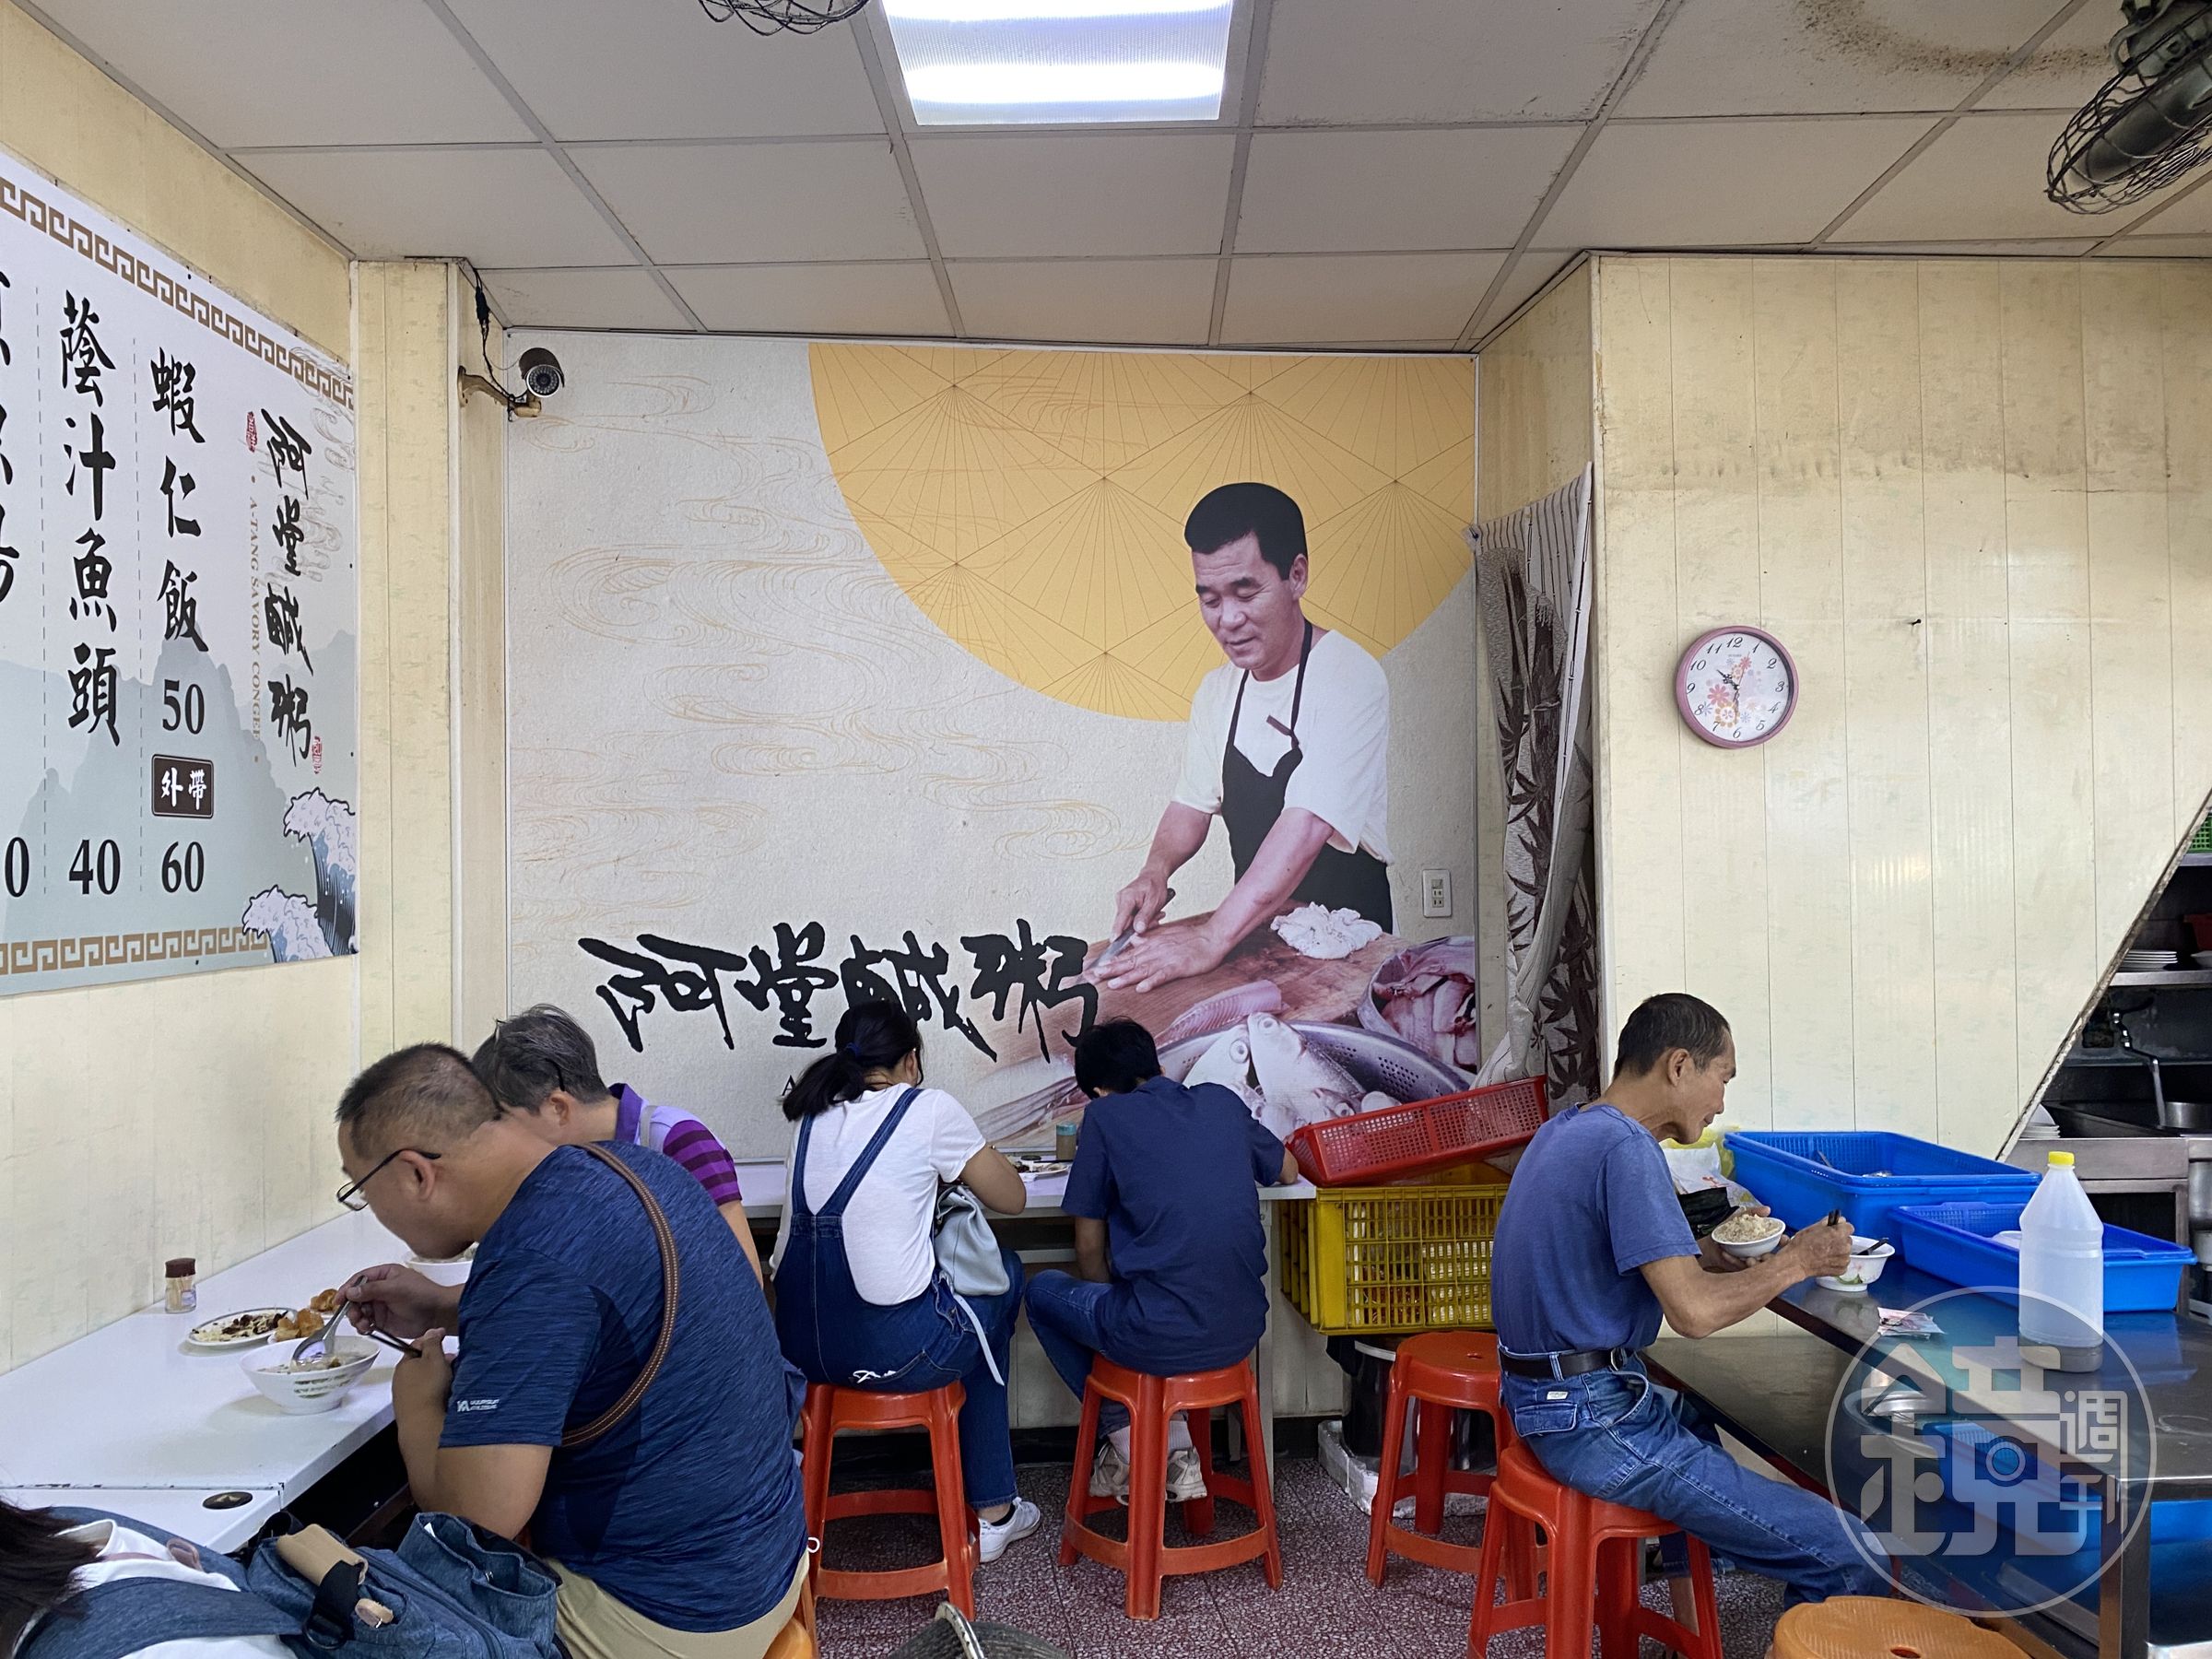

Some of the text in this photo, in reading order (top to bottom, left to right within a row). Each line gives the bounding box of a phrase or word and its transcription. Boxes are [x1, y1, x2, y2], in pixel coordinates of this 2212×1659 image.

[150, 347, 209, 652] 蝦仁飯
[60, 289, 120, 747] 蔭汁魚頭
[250, 497, 259, 571] A-TANG
[250, 576, 260, 655] SAVORY
[1706, 643, 1723, 654] 11
[1726, 636, 1743, 648] 12
[1752, 642, 1760, 653] 1
[1690, 659, 1706, 671] 10
[1767, 657, 1777, 670] 2
[1687, 682, 1696, 695] 9
[1775, 680, 1785, 693] 3
[162, 679, 205, 735] 50
[1694, 703, 1704, 716] 8
[1768, 701, 1781, 714] 4
[1712, 721, 1721, 732] 7
[1733, 726, 1742, 738] 6
[1756, 720, 1766, 731] 5
[161, 767, 207, 810] 外帶
[68, 839, 121, 895] 40
[161, 841, 205, 893] 60
